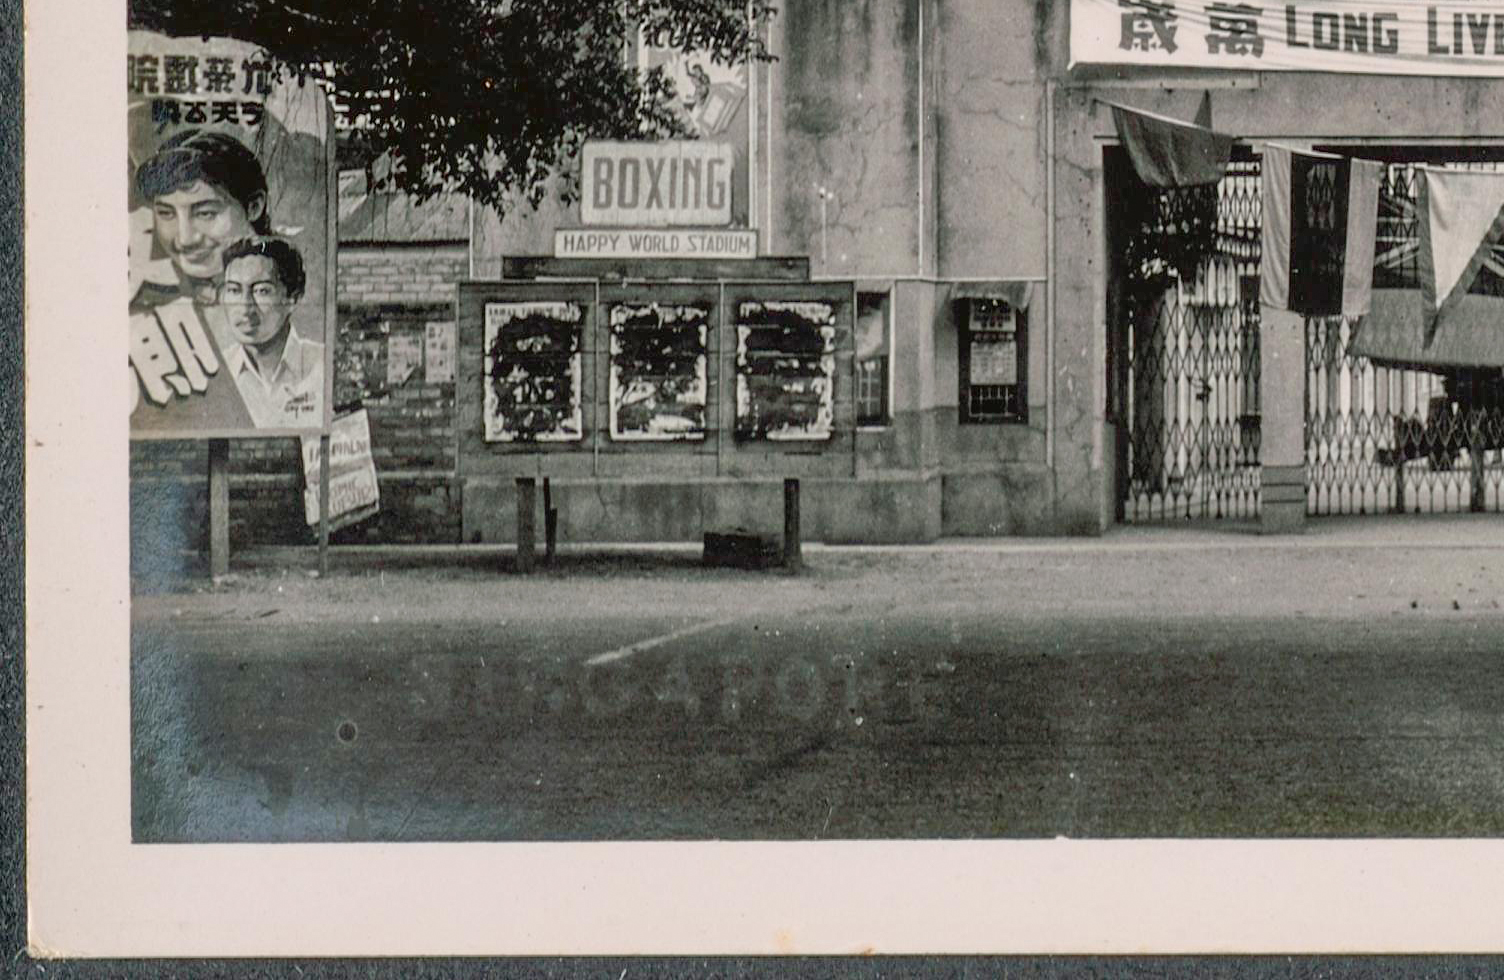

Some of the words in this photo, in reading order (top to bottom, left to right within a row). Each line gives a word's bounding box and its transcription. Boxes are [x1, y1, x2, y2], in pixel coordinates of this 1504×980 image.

[1285, 4, 1398, 54] LONG
[593, 157, 726, 210] BOXING
[564, 235, 620, 252] HAPPY
[629, 235, 680, 252] WORLD
[687, 235, 751, 253] STADIUM
